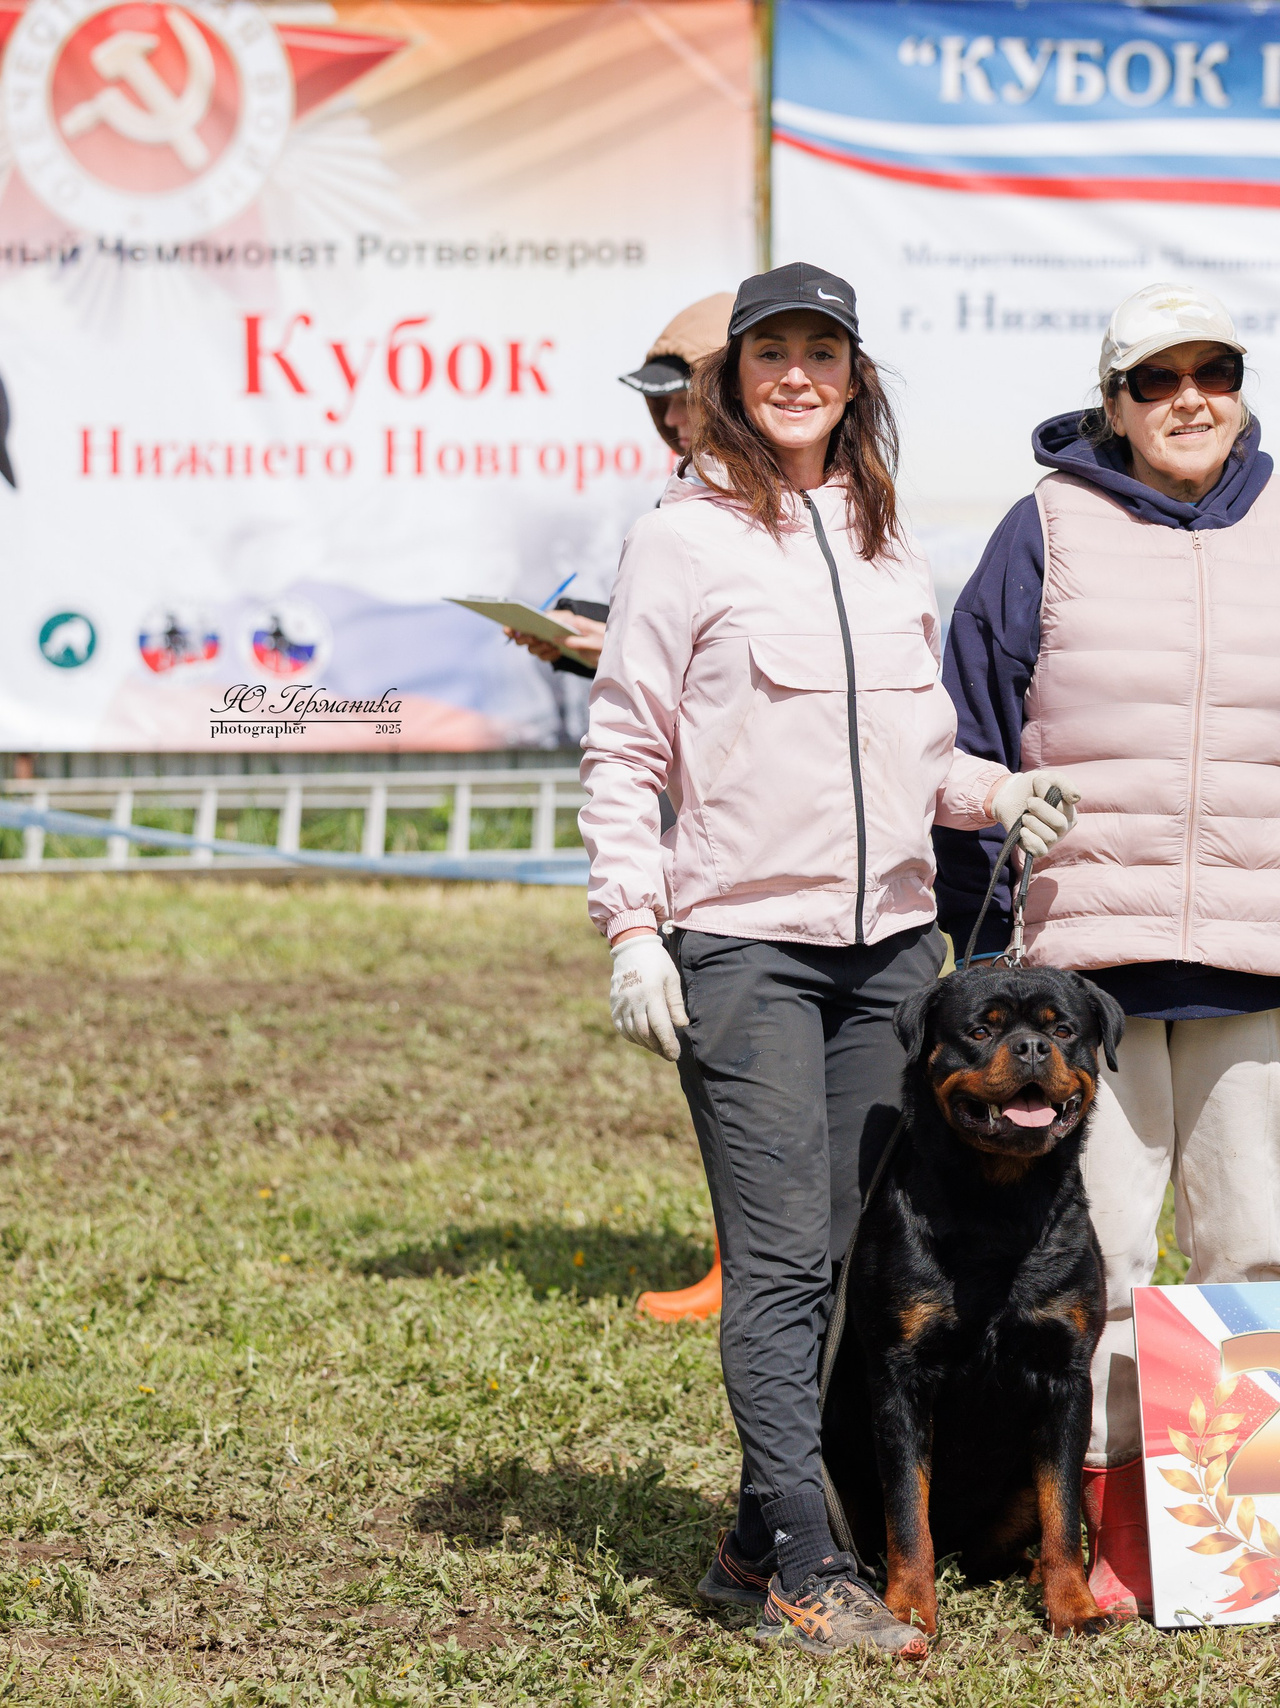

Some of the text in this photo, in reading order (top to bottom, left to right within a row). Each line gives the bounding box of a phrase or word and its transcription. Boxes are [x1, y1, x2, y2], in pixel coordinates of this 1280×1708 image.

[898, 34, 1232, 108] “КУБОК
[98, 236, 336, 267] Чемпионат
[355, 233, 646, 276] Ротвейлеров
[243, 312, 556, 424] Кубок
[77, 426, 677, 494] Нижнего Новгород
